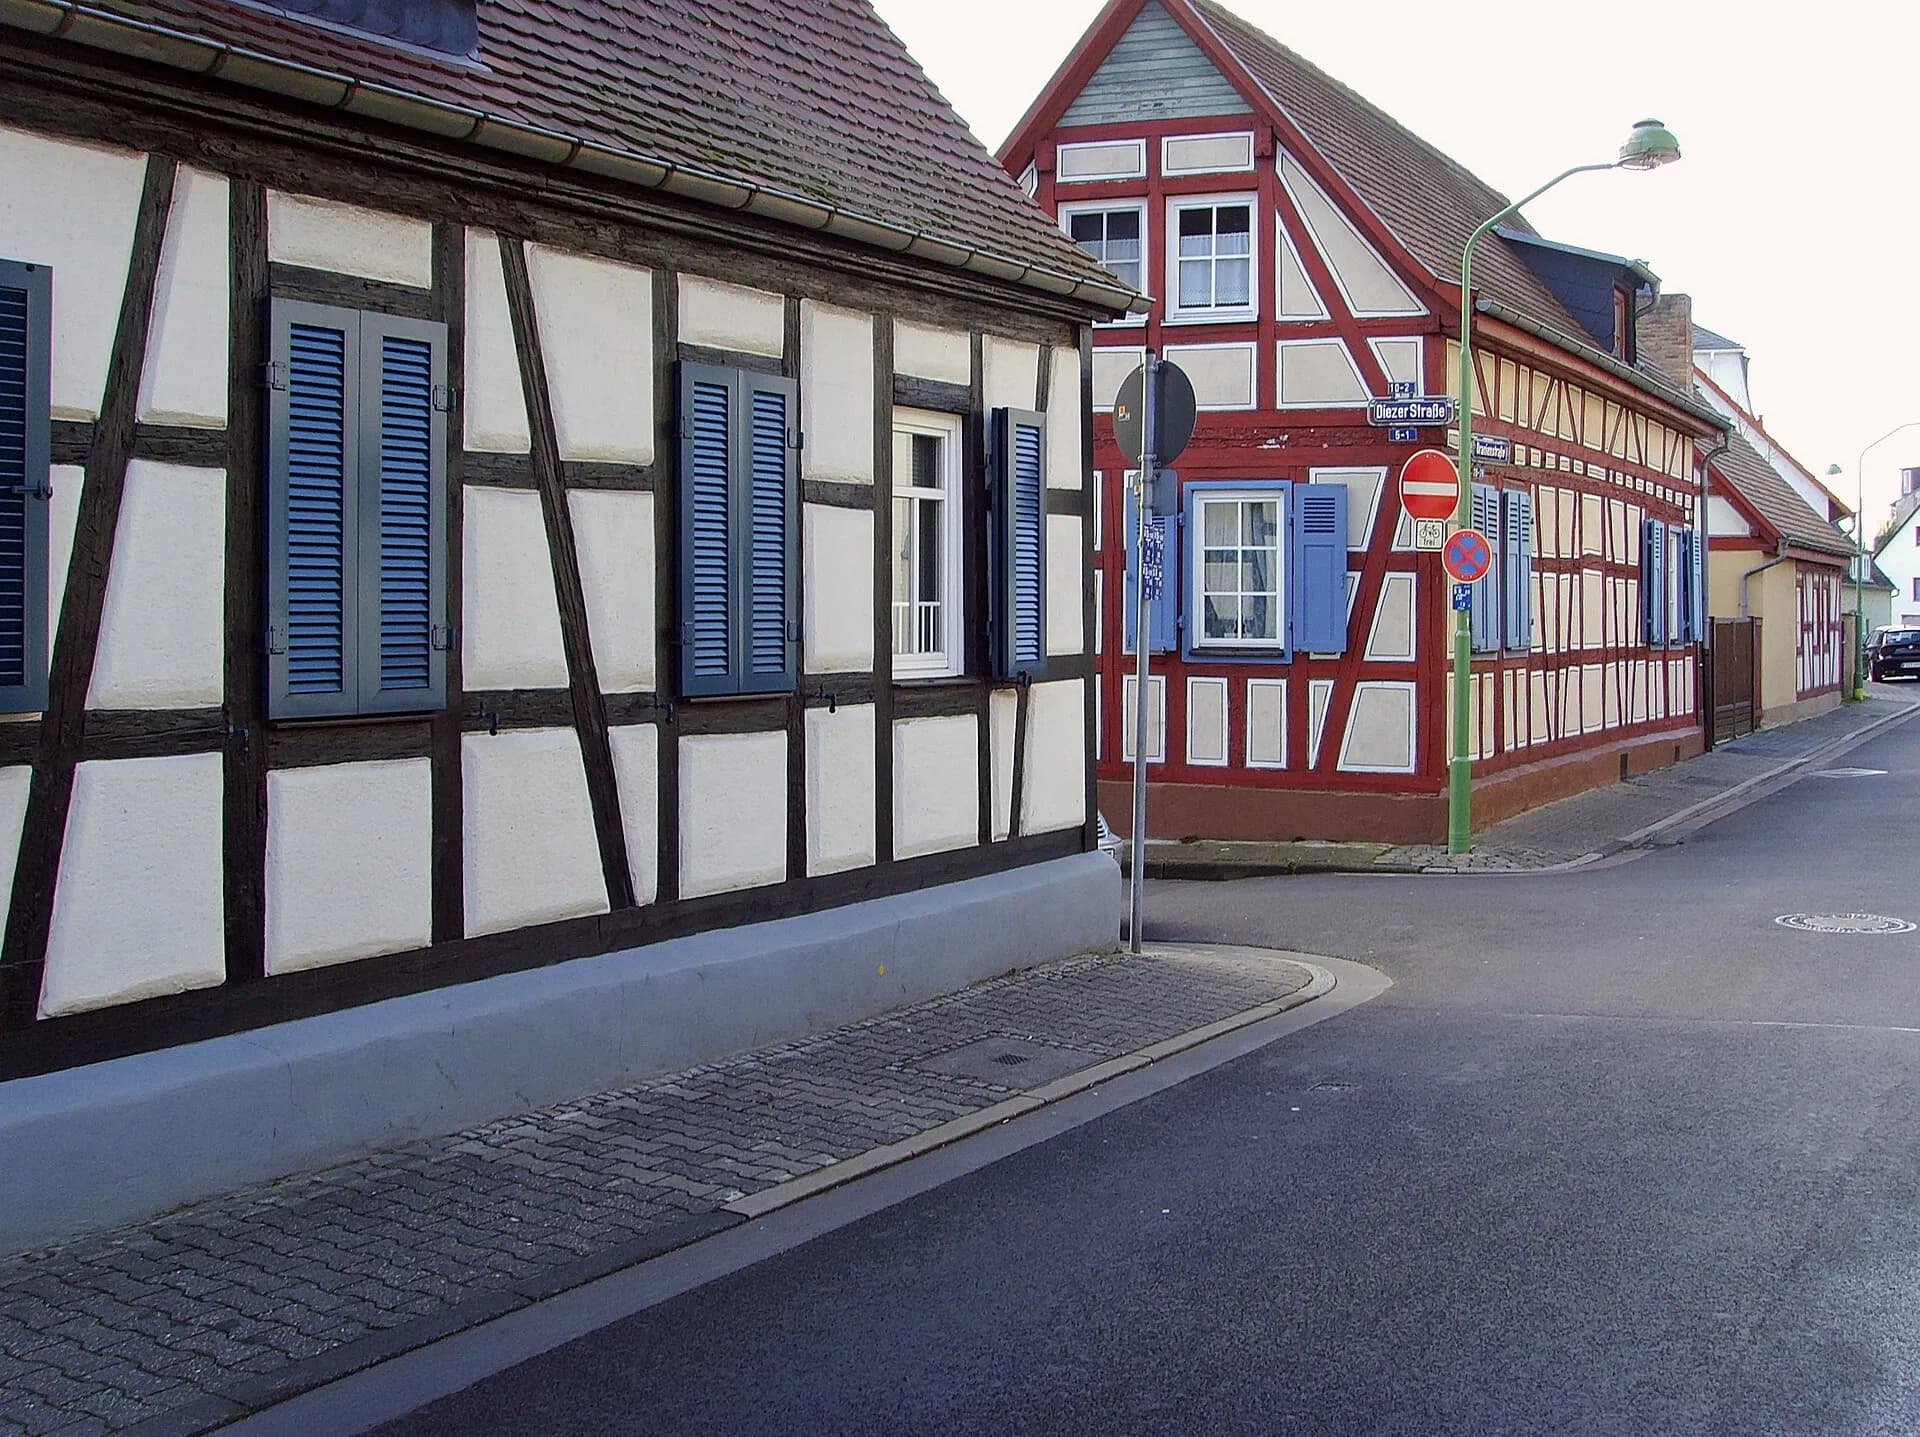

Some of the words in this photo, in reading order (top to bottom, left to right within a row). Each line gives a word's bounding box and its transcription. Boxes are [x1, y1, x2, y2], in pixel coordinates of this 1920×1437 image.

[1390, 383, 1410, 393] 10-2
[1376, 404, 1409, 418] Diezer
[1410, 403, 1445, 418] Straße
[1423, 538, 1436, 546] frei
